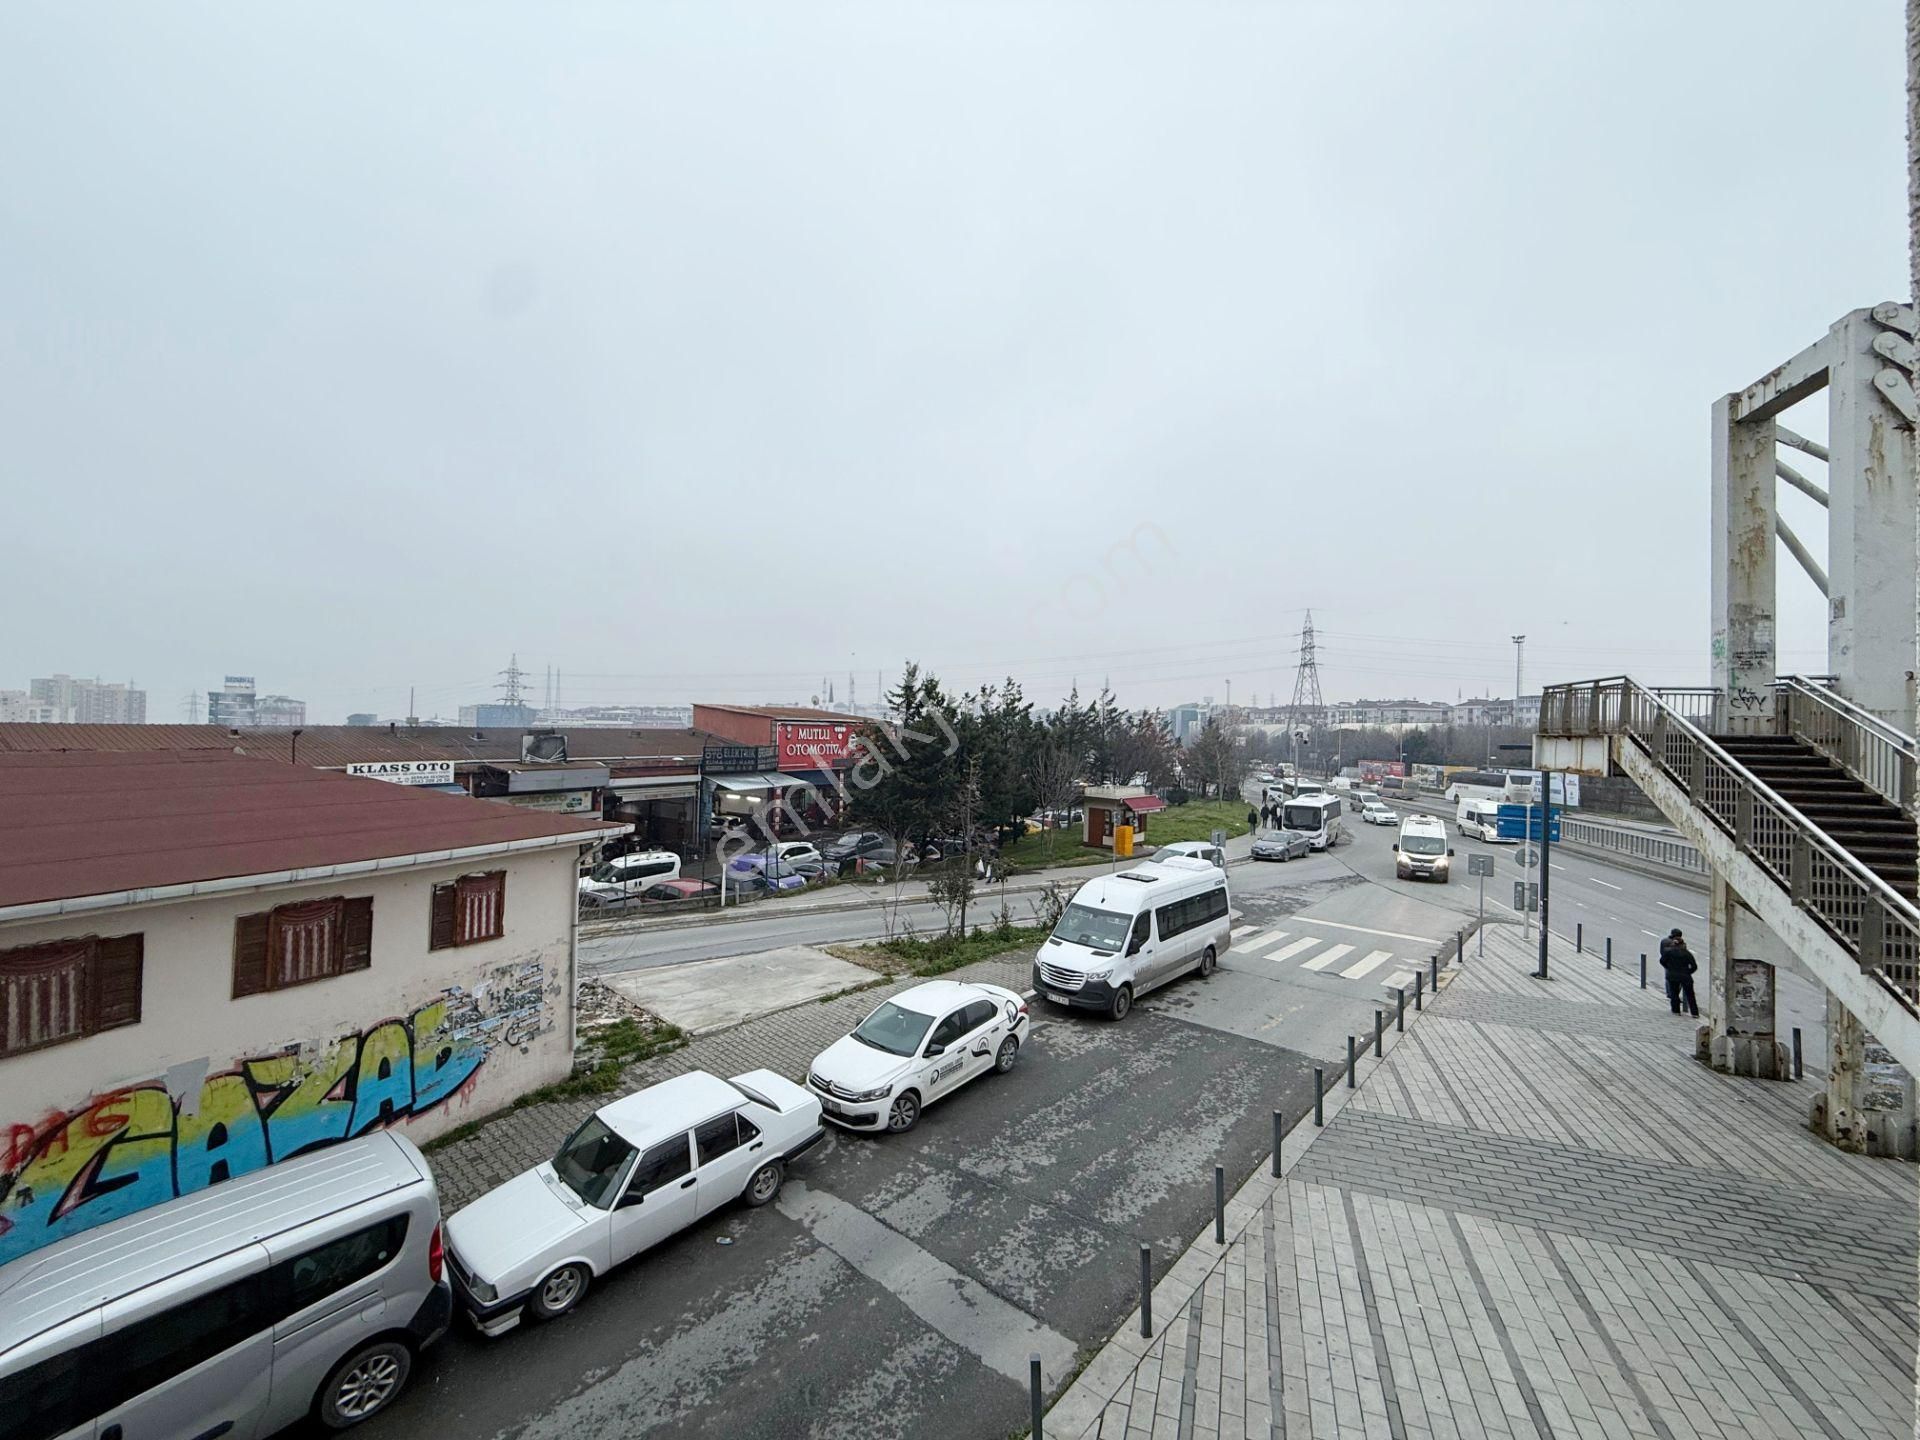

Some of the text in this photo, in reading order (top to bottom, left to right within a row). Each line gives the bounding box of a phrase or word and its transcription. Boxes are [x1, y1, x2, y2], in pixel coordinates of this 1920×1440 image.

[798, 728, 830, 740] MUTLU
[786, 741, 840, 756] OTOMOTİV
[705, 751, 723, 759] OTO
[352, 763, 411, 775] KLASS
[416, 762, 451, 772] OTO
